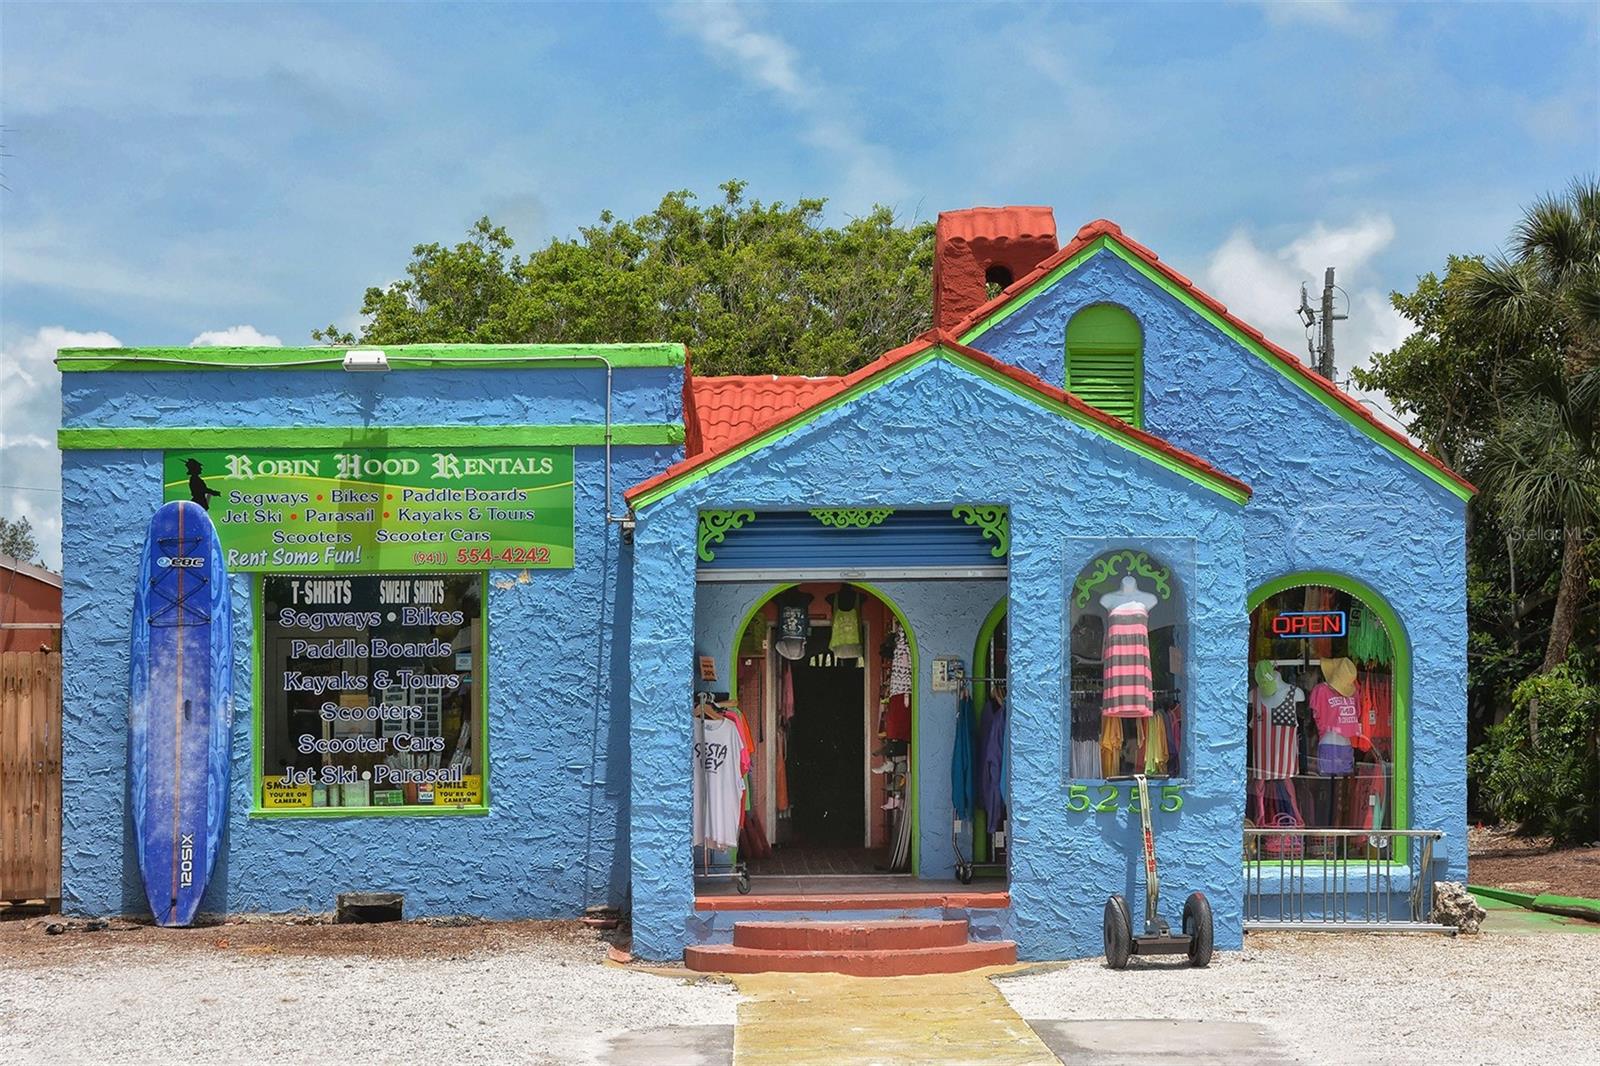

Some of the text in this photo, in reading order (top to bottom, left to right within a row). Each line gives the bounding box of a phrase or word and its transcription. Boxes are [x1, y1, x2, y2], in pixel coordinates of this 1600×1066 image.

[229, 490, 309, 507] Segways
[331, 489, 379, 503] Bikes
[221, 507, 535, 525] Jet Ski Parasail Kayaks & Tours
[272, 527, 491, 545] Scooters Scooter Cars
[227, 544, 362, 567] Rent Some Fun!
[412, 546, 551, 565] (941) 554-4242
[291, 579, 445, 604] T-SHIRTS SWEAT SHIRTS
[279, 606, 464, 632] Segways Bikes
[1272, 615, 1340, 634] OPEN
[283, 669, 460, 695] Kayaks & Tours
[320, 702, 423, 721] Scooters
[298, 733, 445, 754] Scooter Cars
[279, 764, 463, 786] Jet Ski Parasail
[436, 780, 468, 789] SMILE
